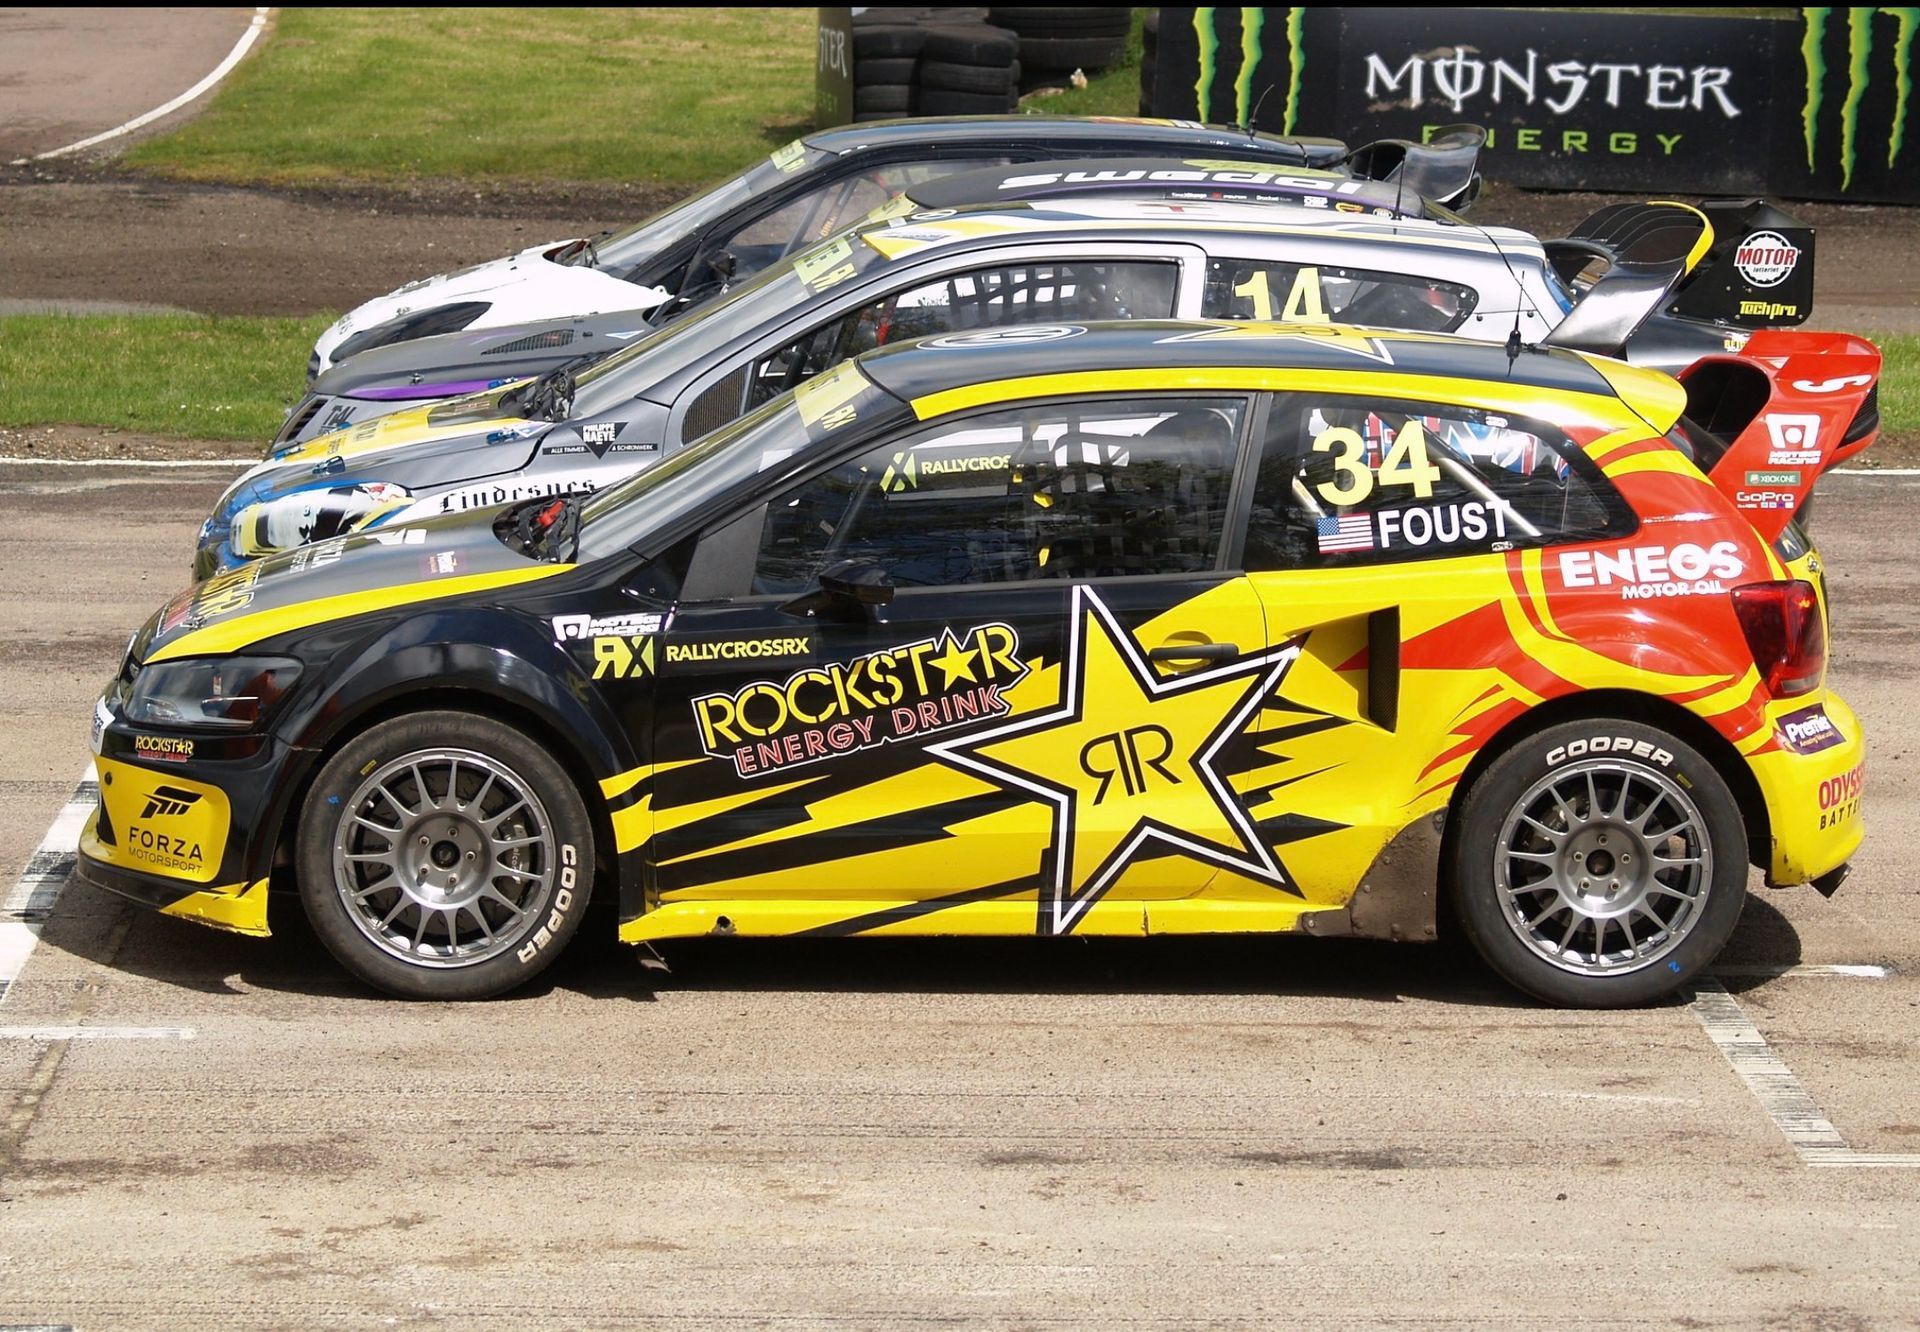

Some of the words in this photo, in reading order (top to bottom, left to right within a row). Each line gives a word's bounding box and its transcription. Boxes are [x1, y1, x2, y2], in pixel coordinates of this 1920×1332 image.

[1364, 48, 1741, 118] MONSTER
[999, 170, 1362, 195] swedol
[1736, 248, 1797, 266] MOTOR
[1235, 267, 1331, 323] 14
[921, 455, 1011, 475] RALLYCROS
[1312, 420, 1441, 506] 34
[1736, 491, 1795, 502] GoPro
[1378, 500, 1511, 548] FOUST
[1559, 541, 1743, 587] ENEOS
[1622, 582, 1691, 600] MOTOR
[1694, 580, 1724, 595] OIL
[666, 637, 810, 662] RALLYCROSSRX
[698, 626, 1021, 750] ROCKSTAR
[135, 735, 194, 755] ROCKSTAR
[736, 716, 875, 774] ENERGY
[892, 684, 1003, 735] DRINK
[1546, 736, 1674, 767] COOPER
[1819, 761, 1866, 810] ODYSS
[128, 846, 203, 874] MOTORSPORT
[129, 826, 203, 862] FORZA
[516, 843, 577, 964] COOPER
